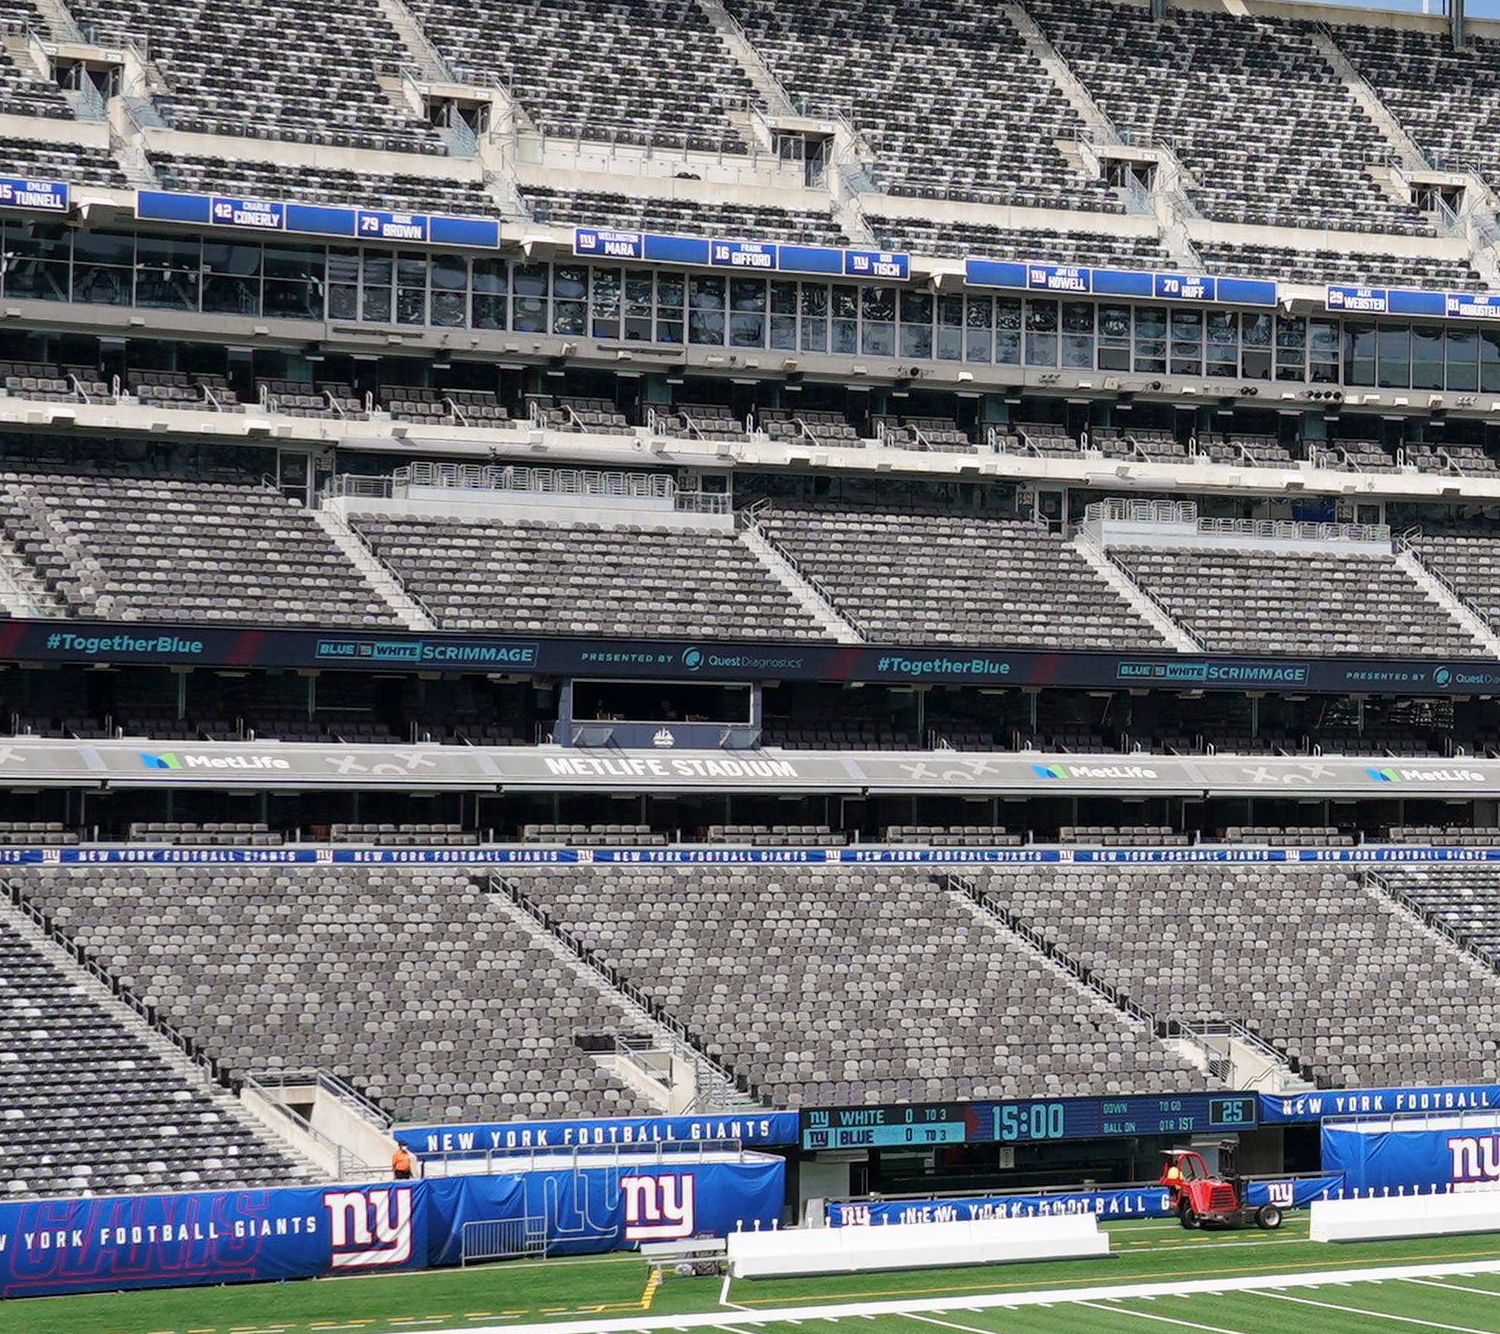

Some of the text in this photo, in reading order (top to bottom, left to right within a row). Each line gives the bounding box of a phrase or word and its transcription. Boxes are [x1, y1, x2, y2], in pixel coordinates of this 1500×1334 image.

[14, 189, 63, 207] TUNNELL
[214, 203, 232, 219] 42
[233, 210, 280, 228] CONERLY
[361, 216, 379, 231] 79
[382, 223, 422, 239] BROWN
[604, 242, 634, 257] MARA
[715, 245, 729, 259] 16
[731, 250, 771, 267] GIFFORD
[873, 261, 900, 277] TISCH
[1049, 275, 1086, 291] HOWELL
[1182, 284, 1205, 299] HUFF
[1345, 297, 1386, 311] WEBSTER
[47, 633, 203, 654] #TogetherBlue
[320, 644, 534, 662] BLUE SCRIMMAGE
[581, 653, 654, 663] PRESENTED
[878, 657, 1010, 675] #TogetherBlue
[1208, 667, 1305, 681] SCRIMMAGE
[184, 755, 290, 769] MetLife
[545, 758, 798, 777] METLIFE STADIUM
[1069, 767, 1158, 778] MetLife
[1400, 769, 1485, 781] MetLife
[1104, 1103, 1128, 1114] DOWN
[1223, 1101, 1243, 1122] 25
[1284, 1099, 1321, 1116] NEW
[1337, 1095, 1382, 1112] YORK
[1397, 1092, 1490, 1110] FOOTBALL
[841, 1109, 884, 1126] WHITE
[992, 1104, 1064, 1140] 15:00
[428, 1120, 767, 1153] NEW YORK FOOTBALL GIANTS
[841, 1130, 874, 1146] BLUE
[1268, 1185, 1294, 1207] ny
[620, 1174, 695, 1240] ny
[25, 1229, 84, 1250] YORK
[102, 1222, 219, 1247] FOOTBALL
[235, 1216, 318, 1238] GIANTS
[323, 1187, 412, 1269] ny
